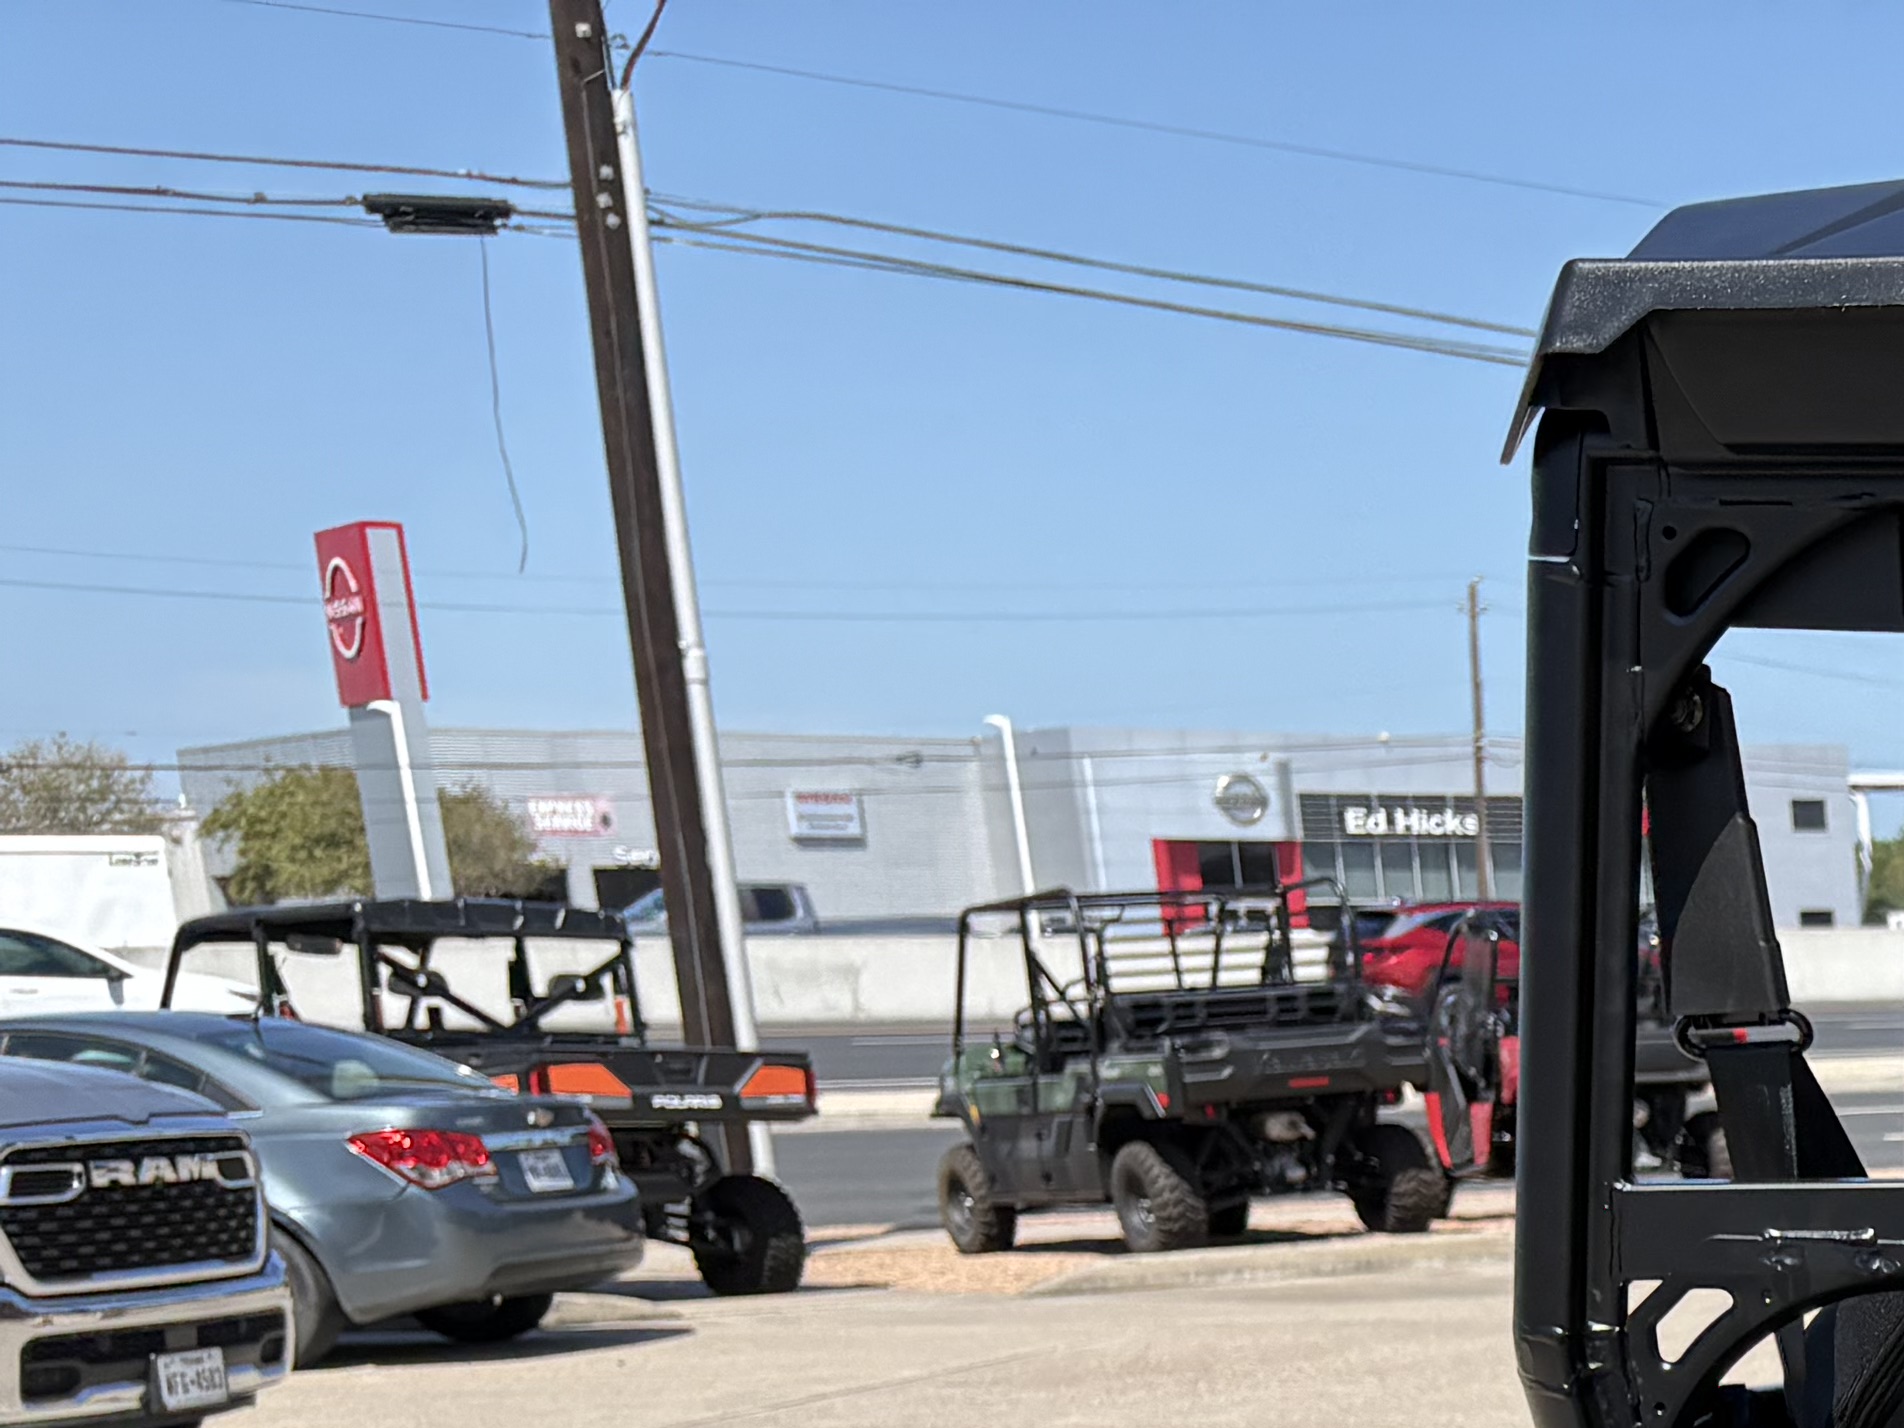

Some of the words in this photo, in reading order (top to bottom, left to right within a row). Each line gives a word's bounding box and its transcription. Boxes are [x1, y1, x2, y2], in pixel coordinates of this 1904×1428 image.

[1344, 807, 1387, 834] Ed
[1394, 807, 1479, 836] Hicks
[90, 1154, 218, 1187] RAM
